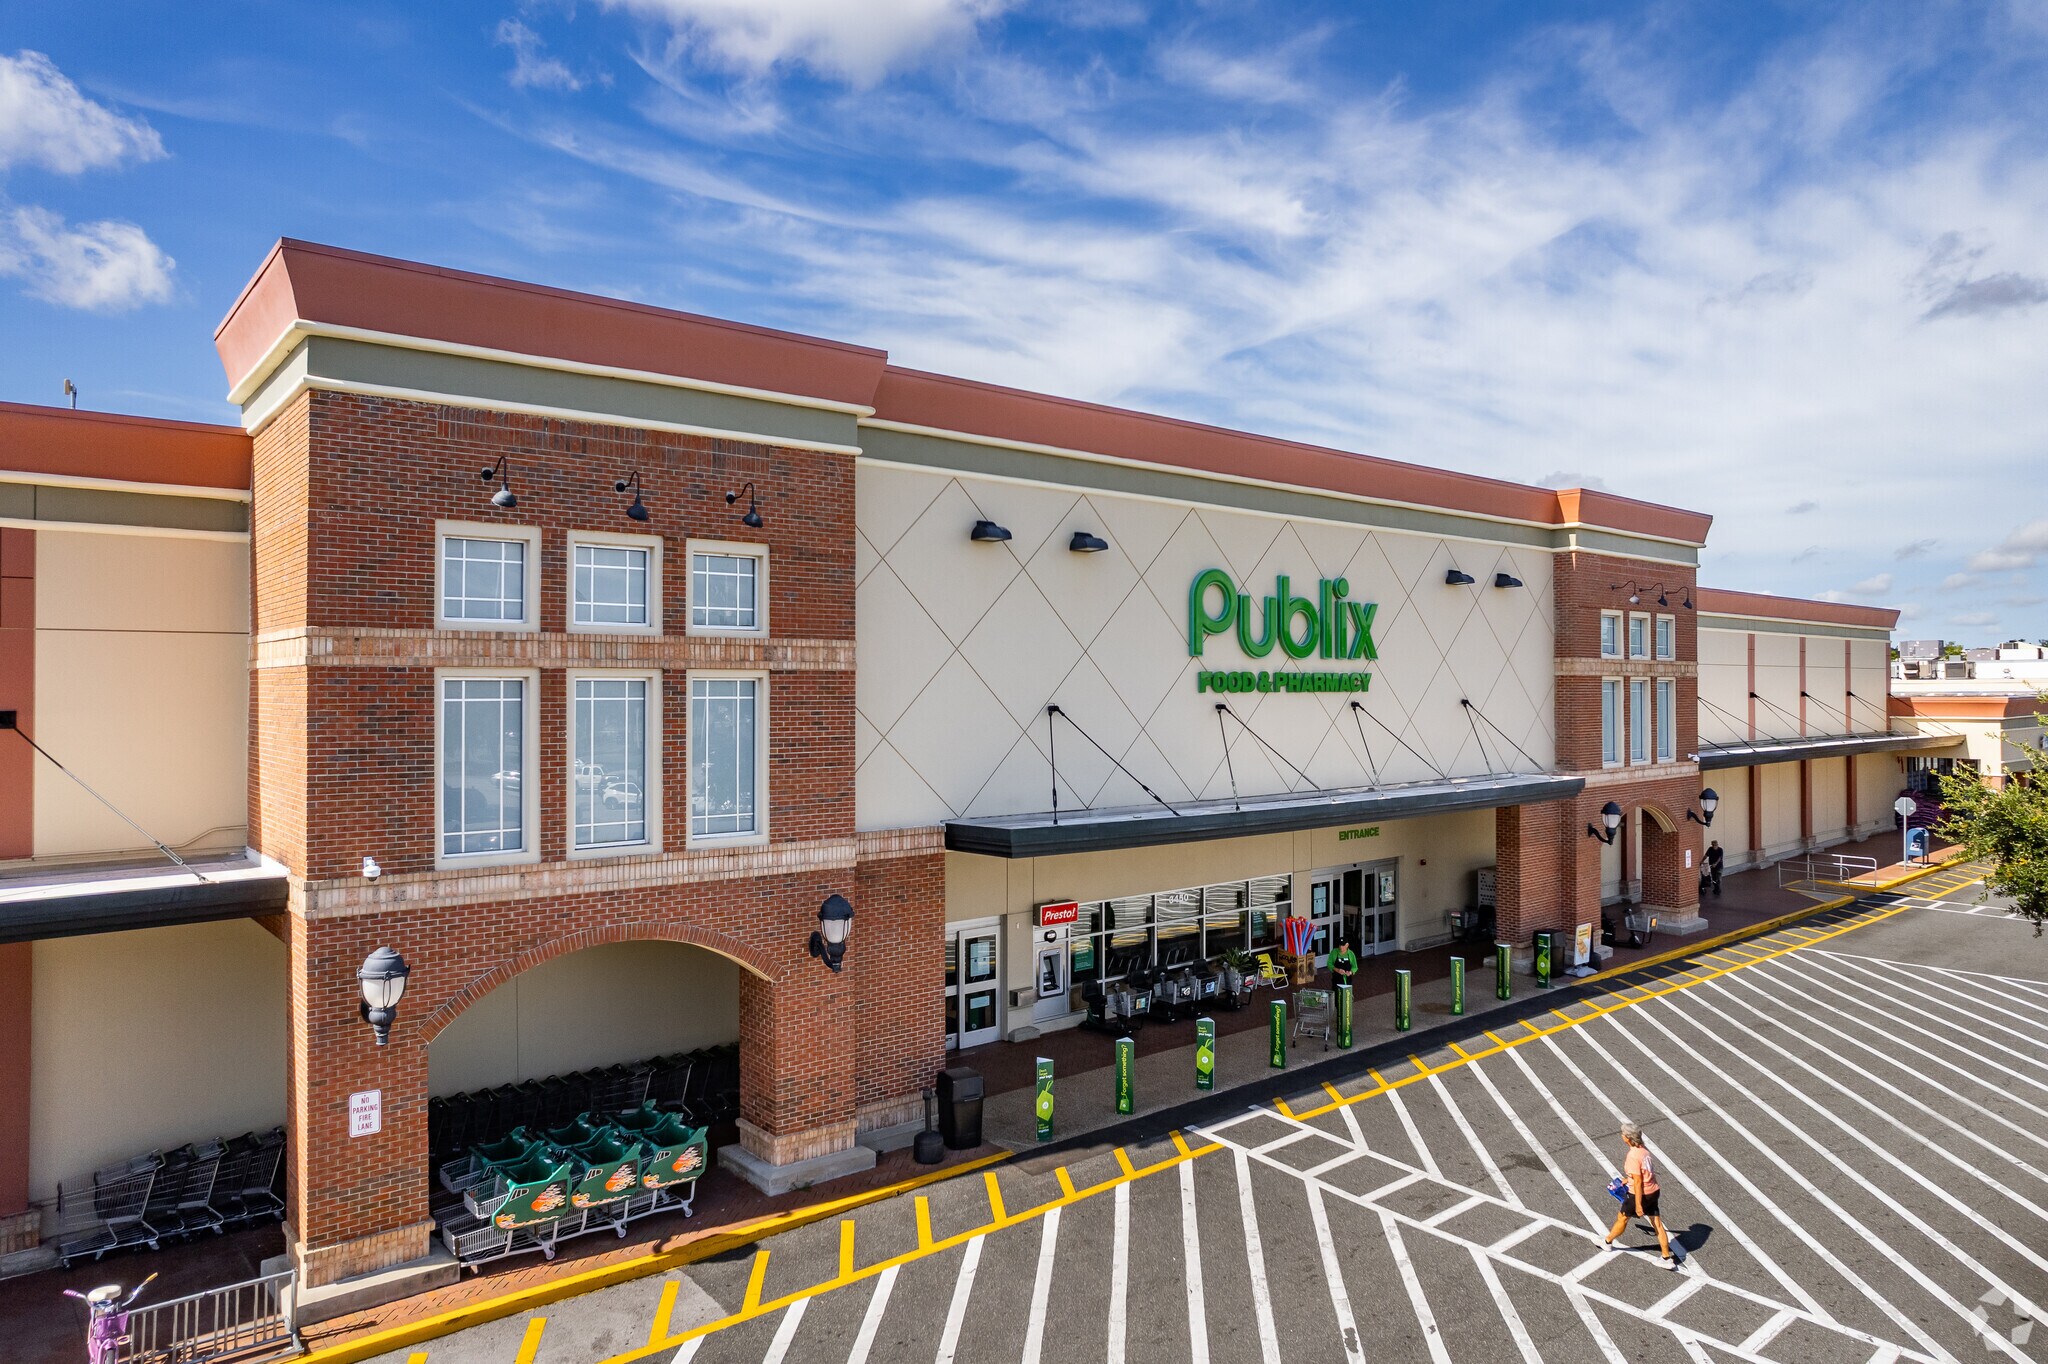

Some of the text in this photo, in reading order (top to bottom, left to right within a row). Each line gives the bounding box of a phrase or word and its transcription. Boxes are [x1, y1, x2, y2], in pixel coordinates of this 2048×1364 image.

[1189, 568, 1379, 660] Publix
[1198, 671, 1372, 693] FOOD & PHARMACY
[1339, 826, 1380, 841] ENTRANCE
[1044, 907, 1076, 922] Presto!
[1121, 1044, 1129, 1077] something?
[353, 1104, 378, 1114] PARKING
[359, 1113, 371, 1121] FIRE
[358, 1122, 372, 1130] LANE
